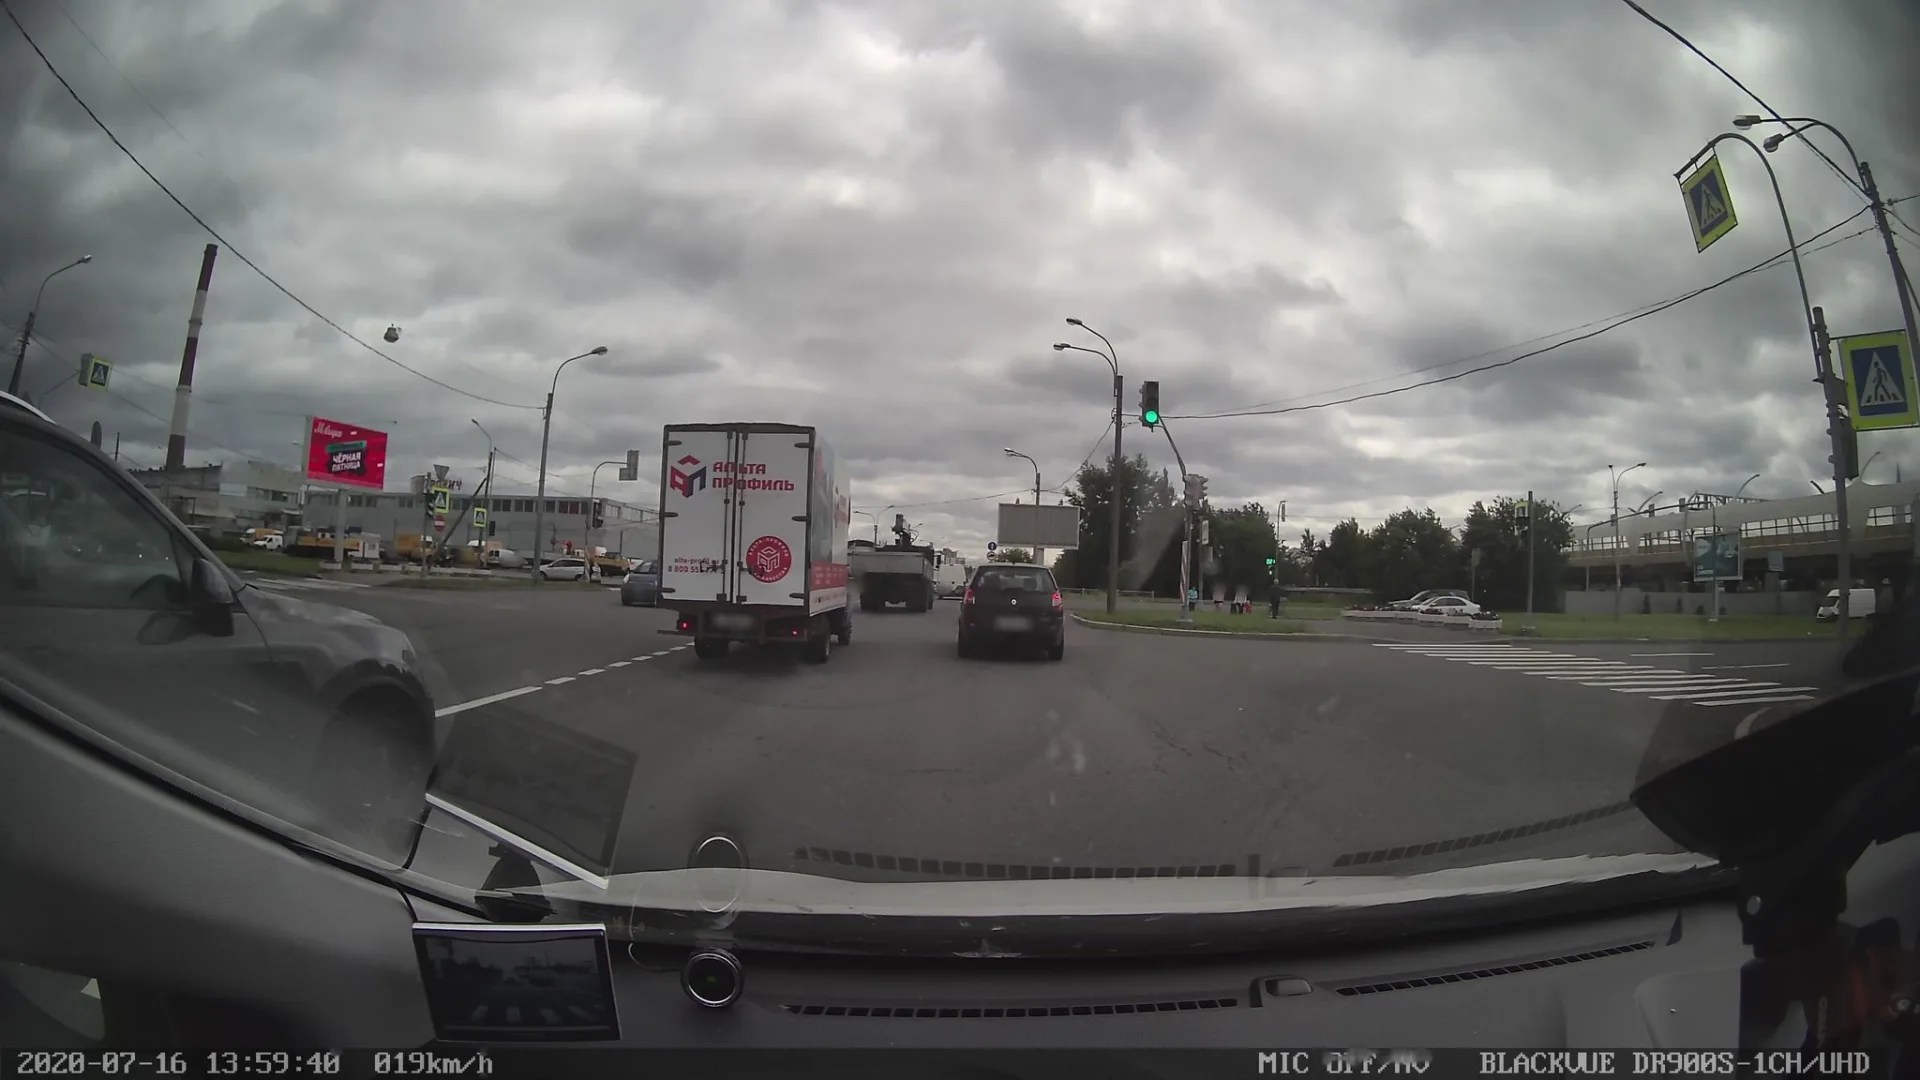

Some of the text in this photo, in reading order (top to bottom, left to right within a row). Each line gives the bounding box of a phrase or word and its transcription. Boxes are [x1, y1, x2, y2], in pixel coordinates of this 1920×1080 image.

[333, 452, 361, 463] ЧЁРНАЯ
[332, 461, 360, 472] ПЯТНИЦА
[712, 462, 766, 475] АЛЬТА
[712, 477, 794, 491] ПРОФИЛЬ
